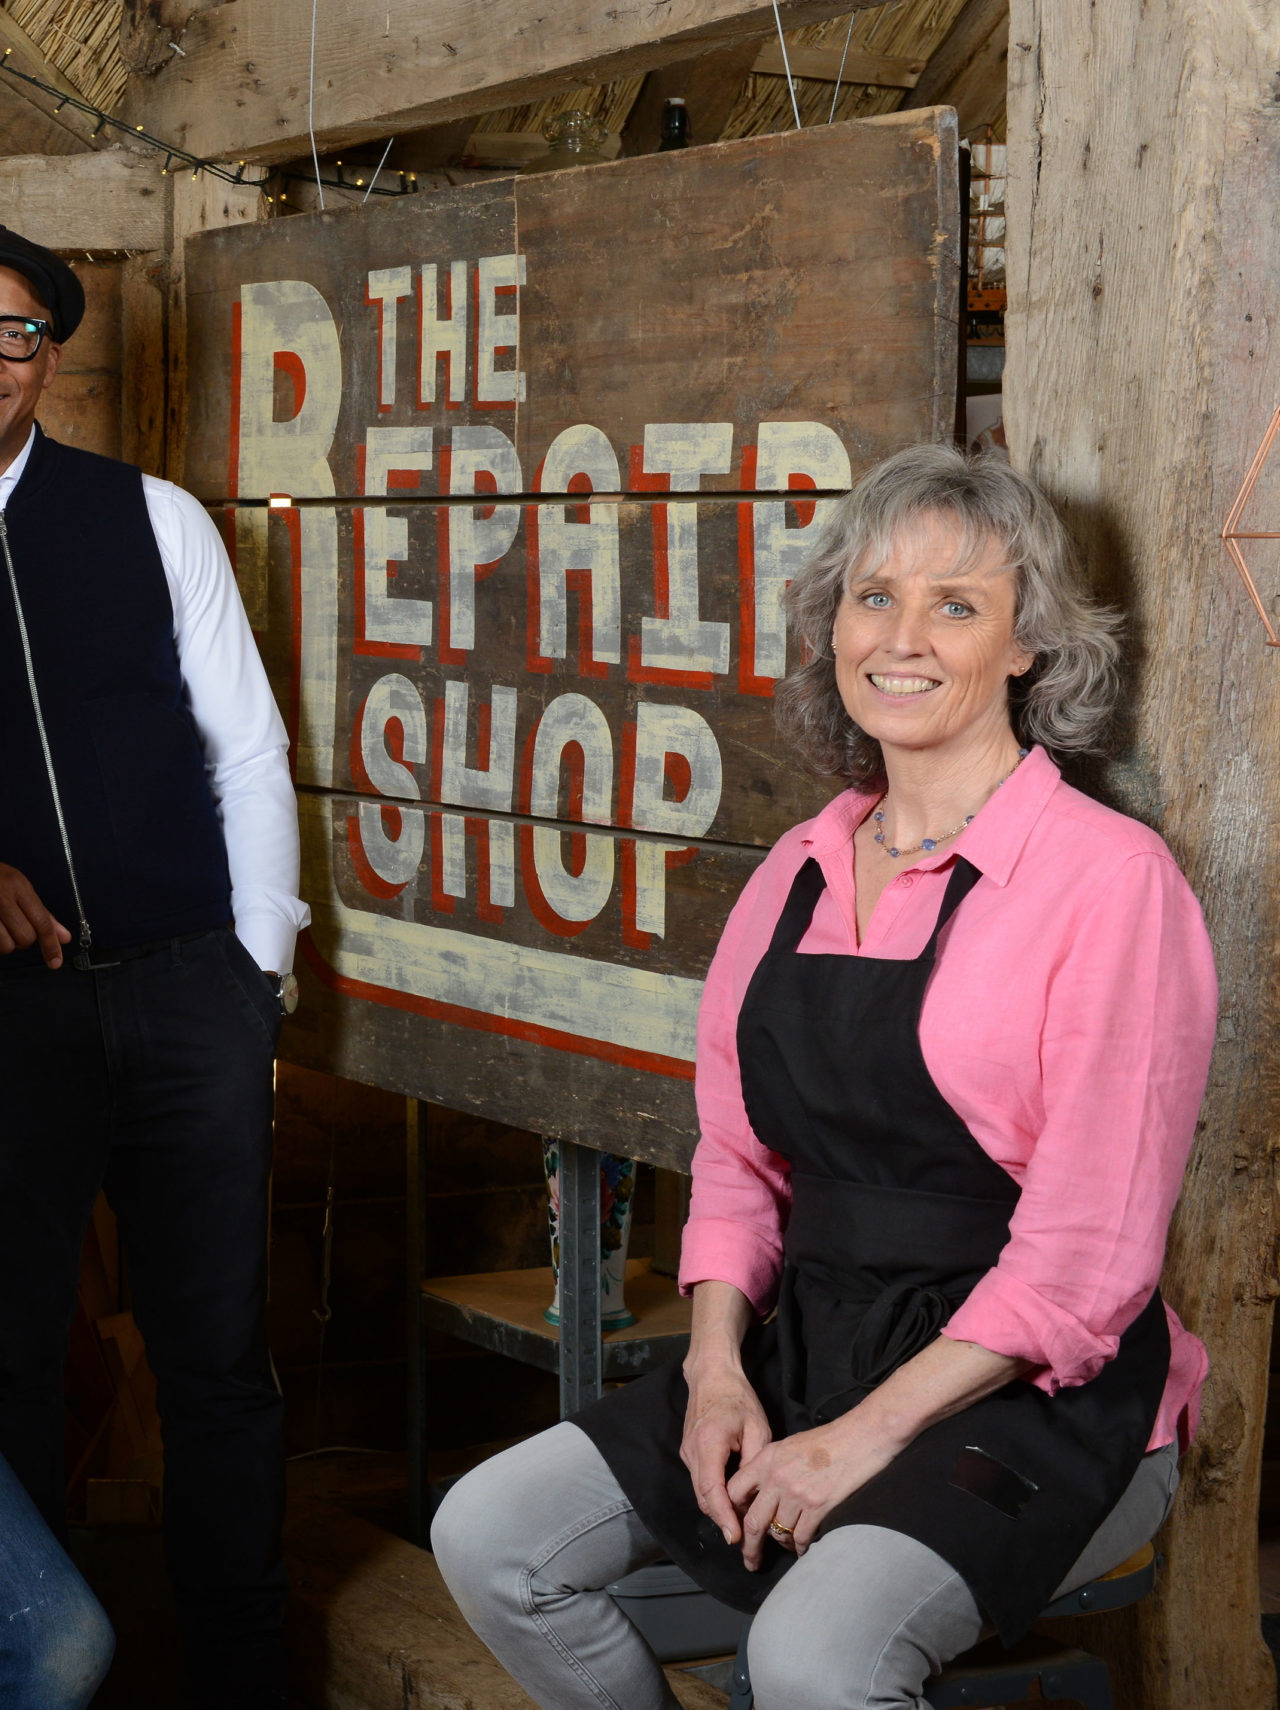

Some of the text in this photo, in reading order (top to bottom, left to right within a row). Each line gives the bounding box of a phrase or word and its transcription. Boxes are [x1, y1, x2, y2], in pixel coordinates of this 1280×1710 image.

[366, 254, 527, 412] THE
[230, 280, 852, 698] REPAIR
[350, 673, 723, 950] SHOP
